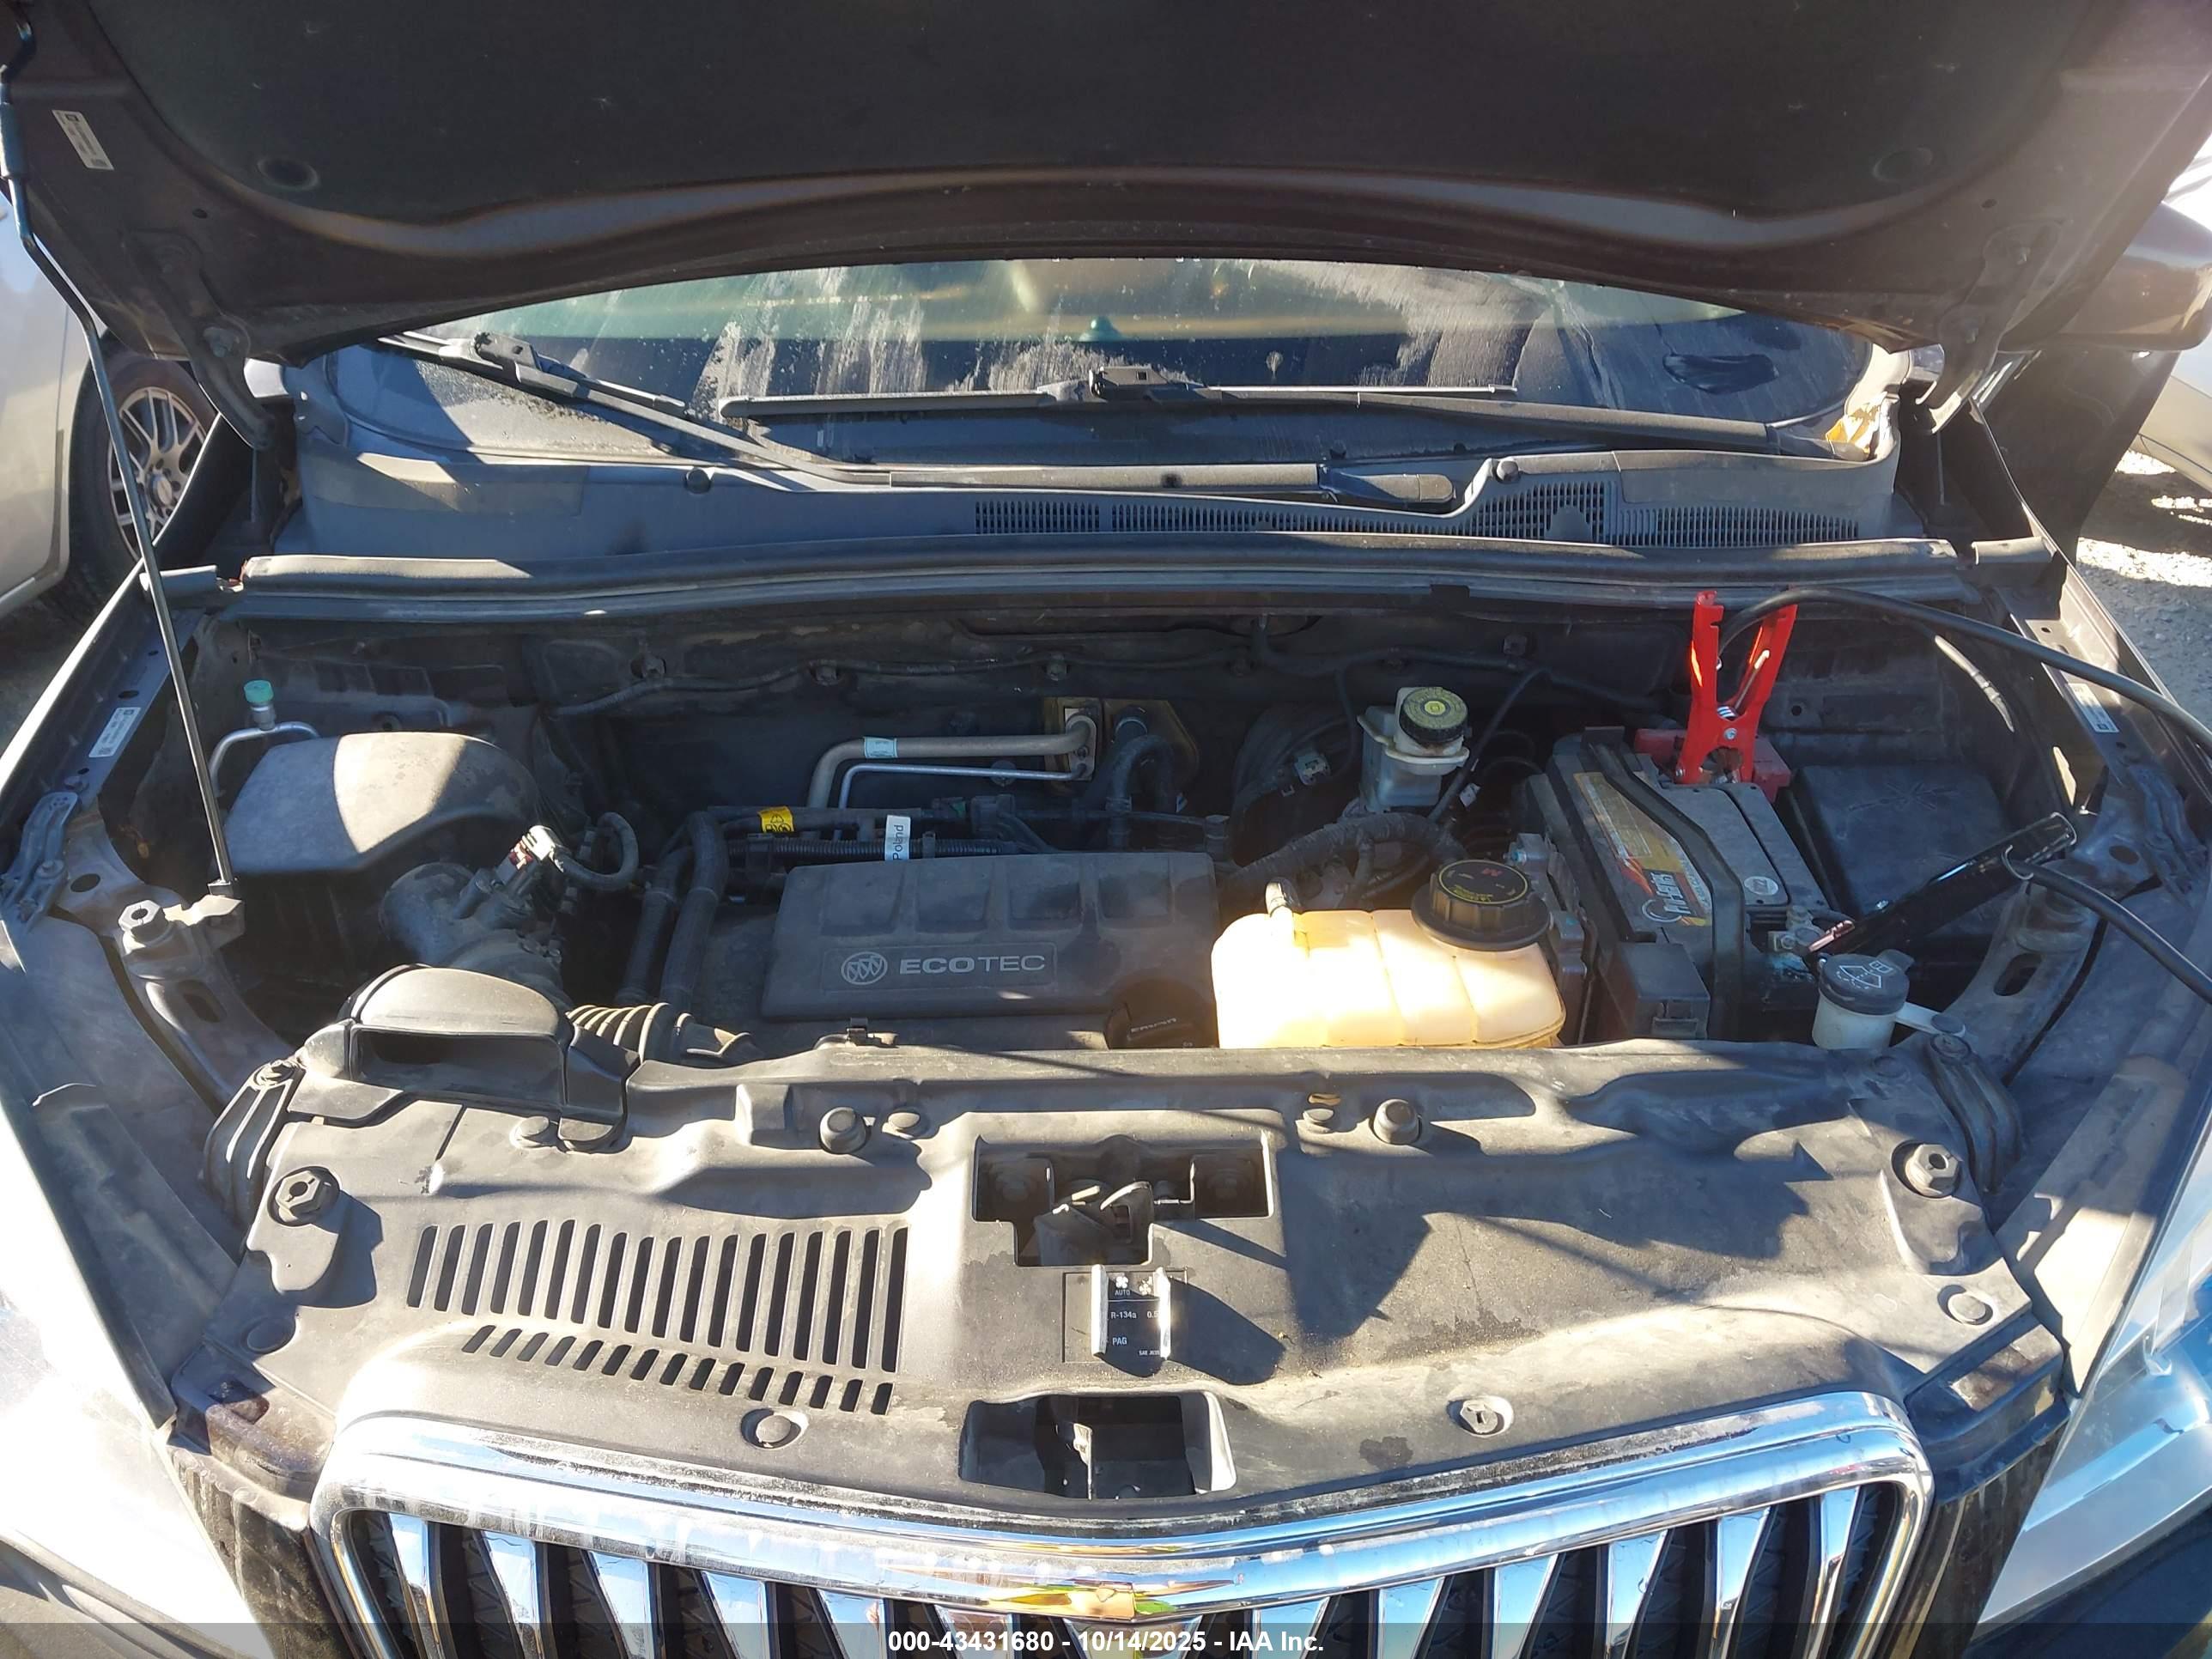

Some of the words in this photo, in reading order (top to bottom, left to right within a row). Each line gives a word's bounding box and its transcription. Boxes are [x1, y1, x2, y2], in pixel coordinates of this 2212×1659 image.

[892, 824, 904, 860] Poland
[899, 955, 1045, 975] ECOTEC
[1110, 1311, 1137, 1320] R-134a
[1112, 1337, 1127, 1346] PAG
